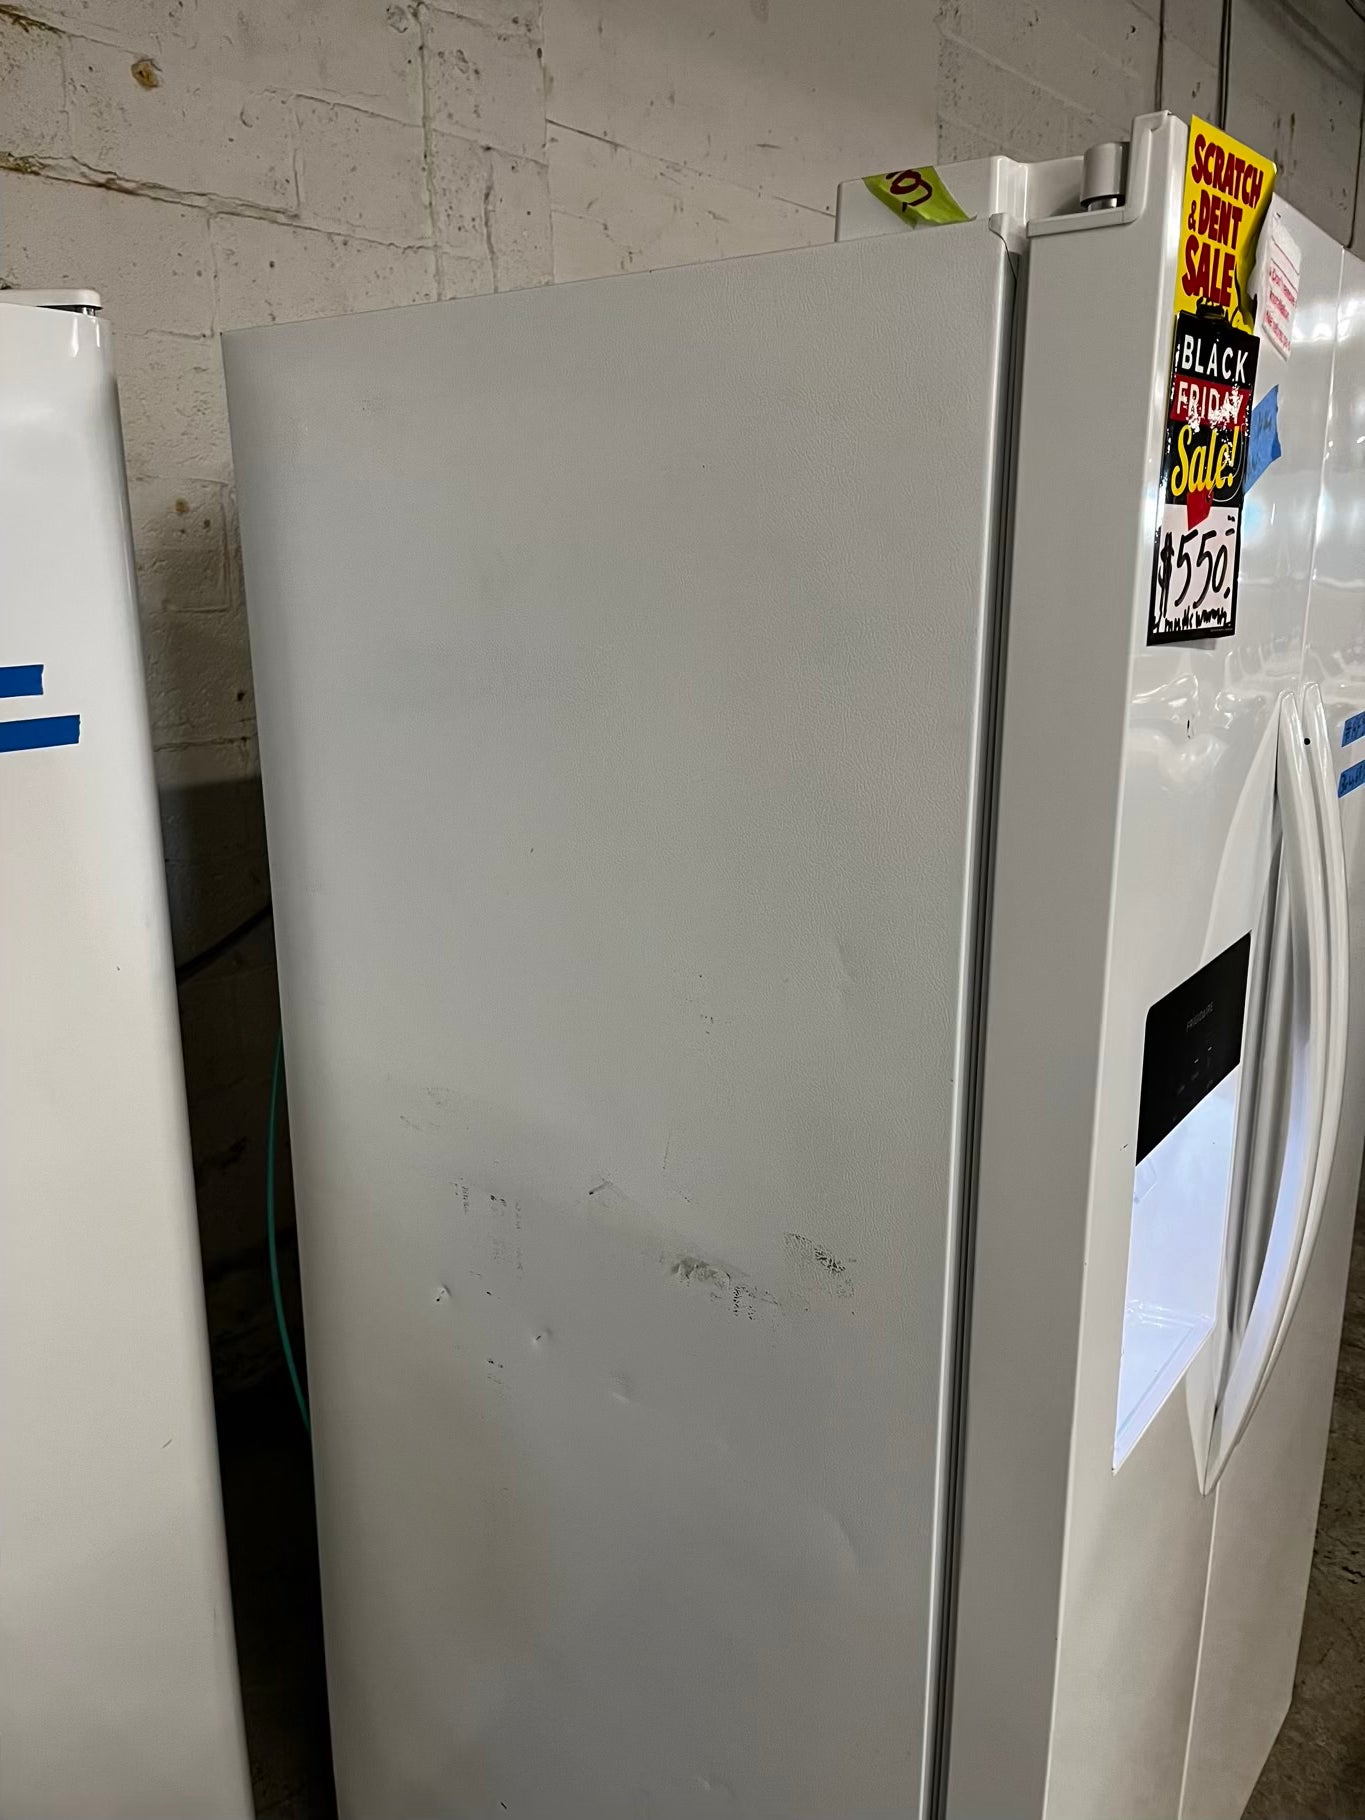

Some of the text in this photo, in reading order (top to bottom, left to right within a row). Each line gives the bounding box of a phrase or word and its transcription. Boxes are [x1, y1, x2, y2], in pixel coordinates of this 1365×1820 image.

[1191, 133, 1264, 210] SCRATCH
[1187, 189, 1244, 250] & DENT
[1181, 234, 1236, 308] SALE
[1181, 334, 1249, 384] BLACK
[1176, 380, 1244, 425] FRIDAY
[1170, 424, 1240, 498] Sale!
